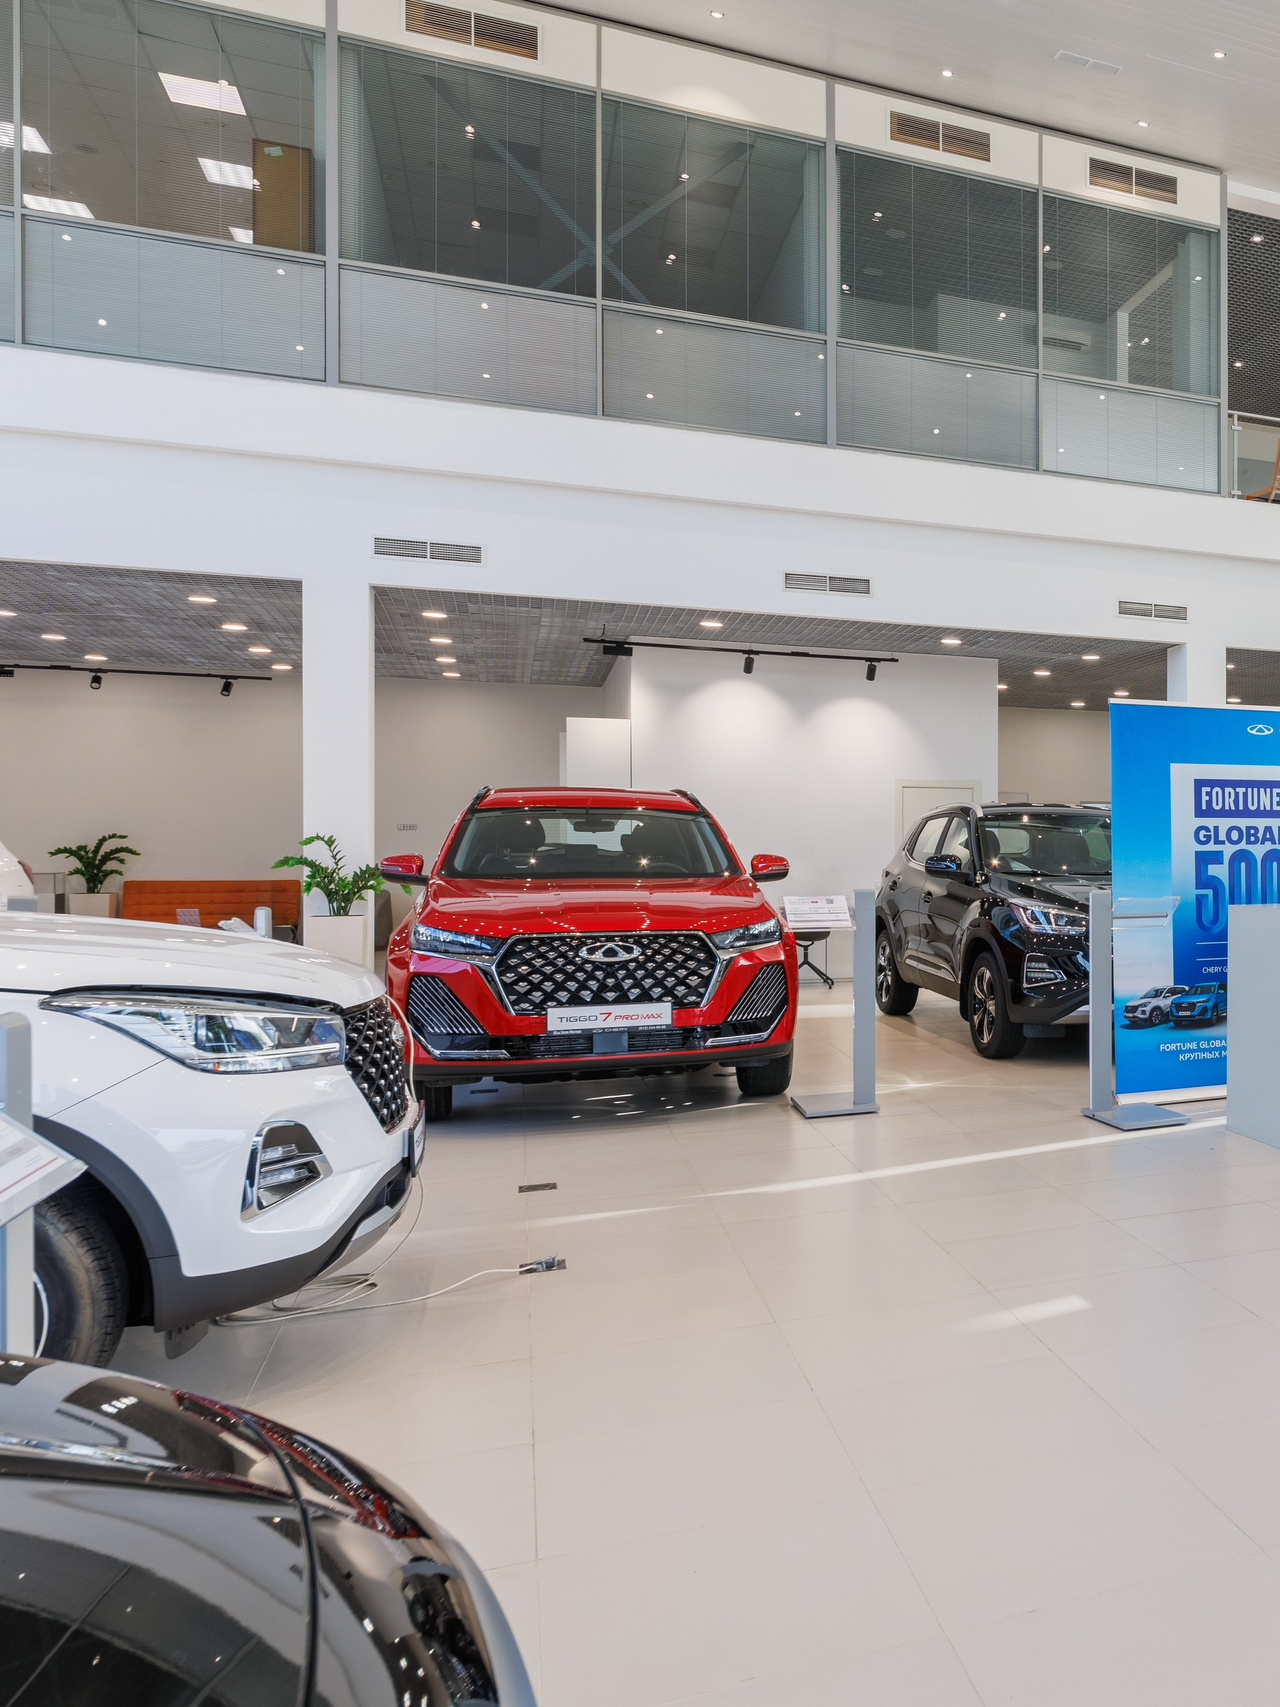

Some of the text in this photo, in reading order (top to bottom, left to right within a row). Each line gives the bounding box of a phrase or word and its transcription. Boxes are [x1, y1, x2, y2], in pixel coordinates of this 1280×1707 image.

[1202, 966, 1221, 974] CHERY
[557, 1015, 598, 1023] TIGGO
[599, 1012, 613, 1022] 7
[1160, 1039, 1227, 1052] FORTUNE GLOBA
[1179, 1050, 1220, 1061] КРУПНЫХ
